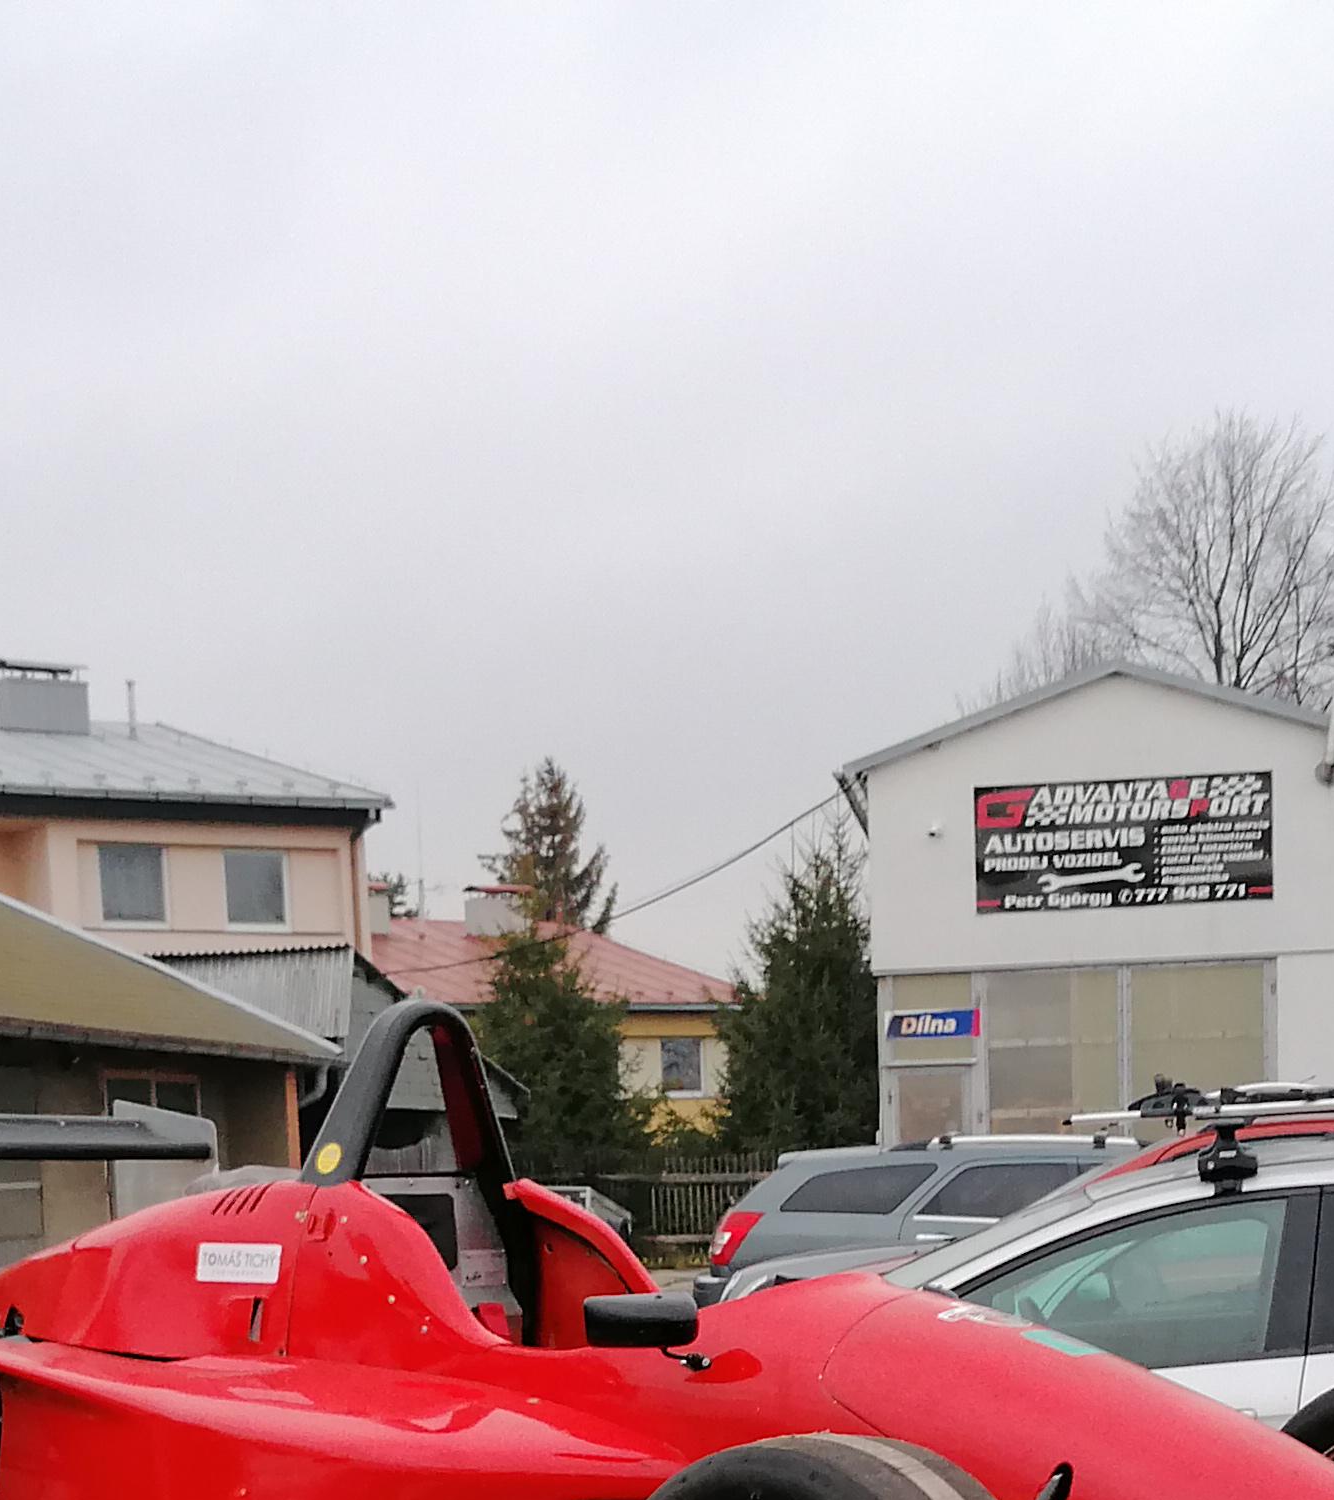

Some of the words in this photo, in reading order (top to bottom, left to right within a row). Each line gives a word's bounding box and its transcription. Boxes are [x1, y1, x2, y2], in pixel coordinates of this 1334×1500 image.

[1027, 778, 1208, 808] ADVANTAGE
[1068, 793, 1269, 825] MOTORSPORT
[984, 827, 1145, 854] AUTOSERVIS
[984, 855, 1048, 872] PRODEJ
[1053, 852, 1123, 868] VOZIDEL
[1004, 894, 1044, 909] Petr
[1134, 887, 1168, 903] 777
[1215, 883, 1246, 899] 771
[900, 1014, 957, 1035] Dílna
